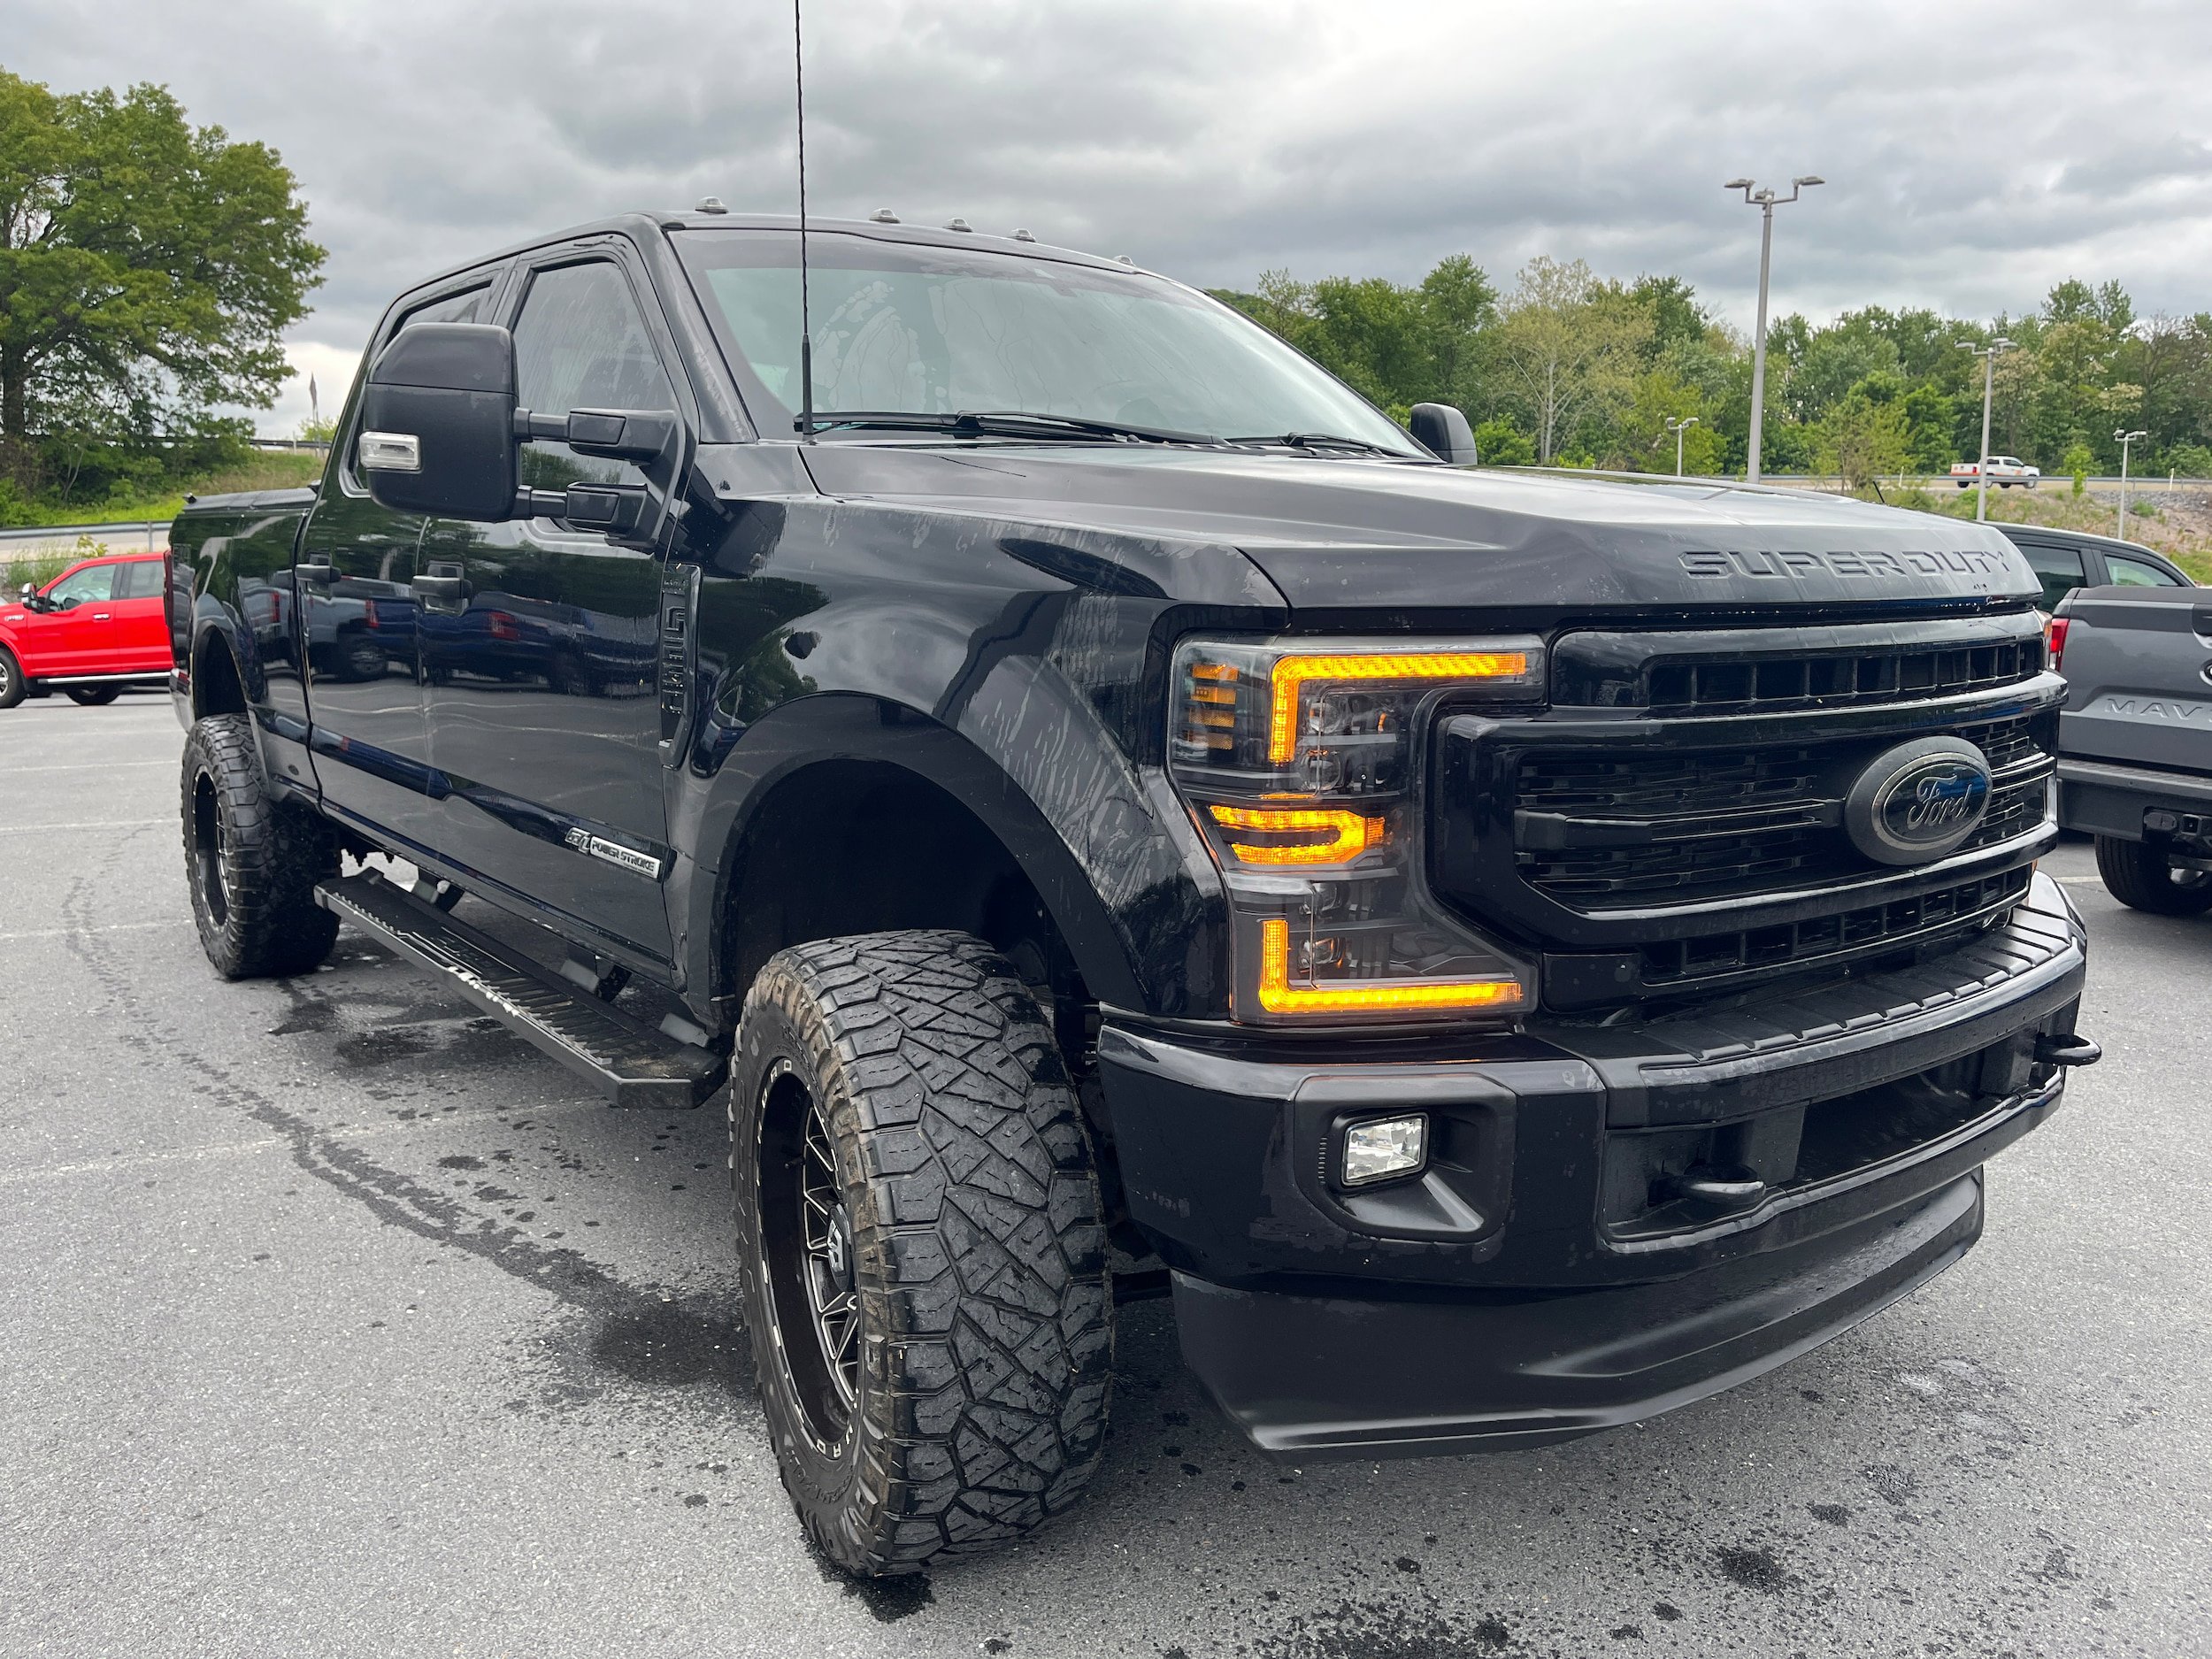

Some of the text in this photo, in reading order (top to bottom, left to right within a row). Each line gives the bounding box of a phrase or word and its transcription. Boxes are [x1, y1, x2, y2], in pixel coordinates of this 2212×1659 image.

[1678, 549, 2012, 580] SUPER DUTY
[2104, 698, 2212, 723] MAV
[1906, 772, 1973, 831] Ford
[591, 839, 619, 859] POWER
[620, 850, 656, 872] STROKE
